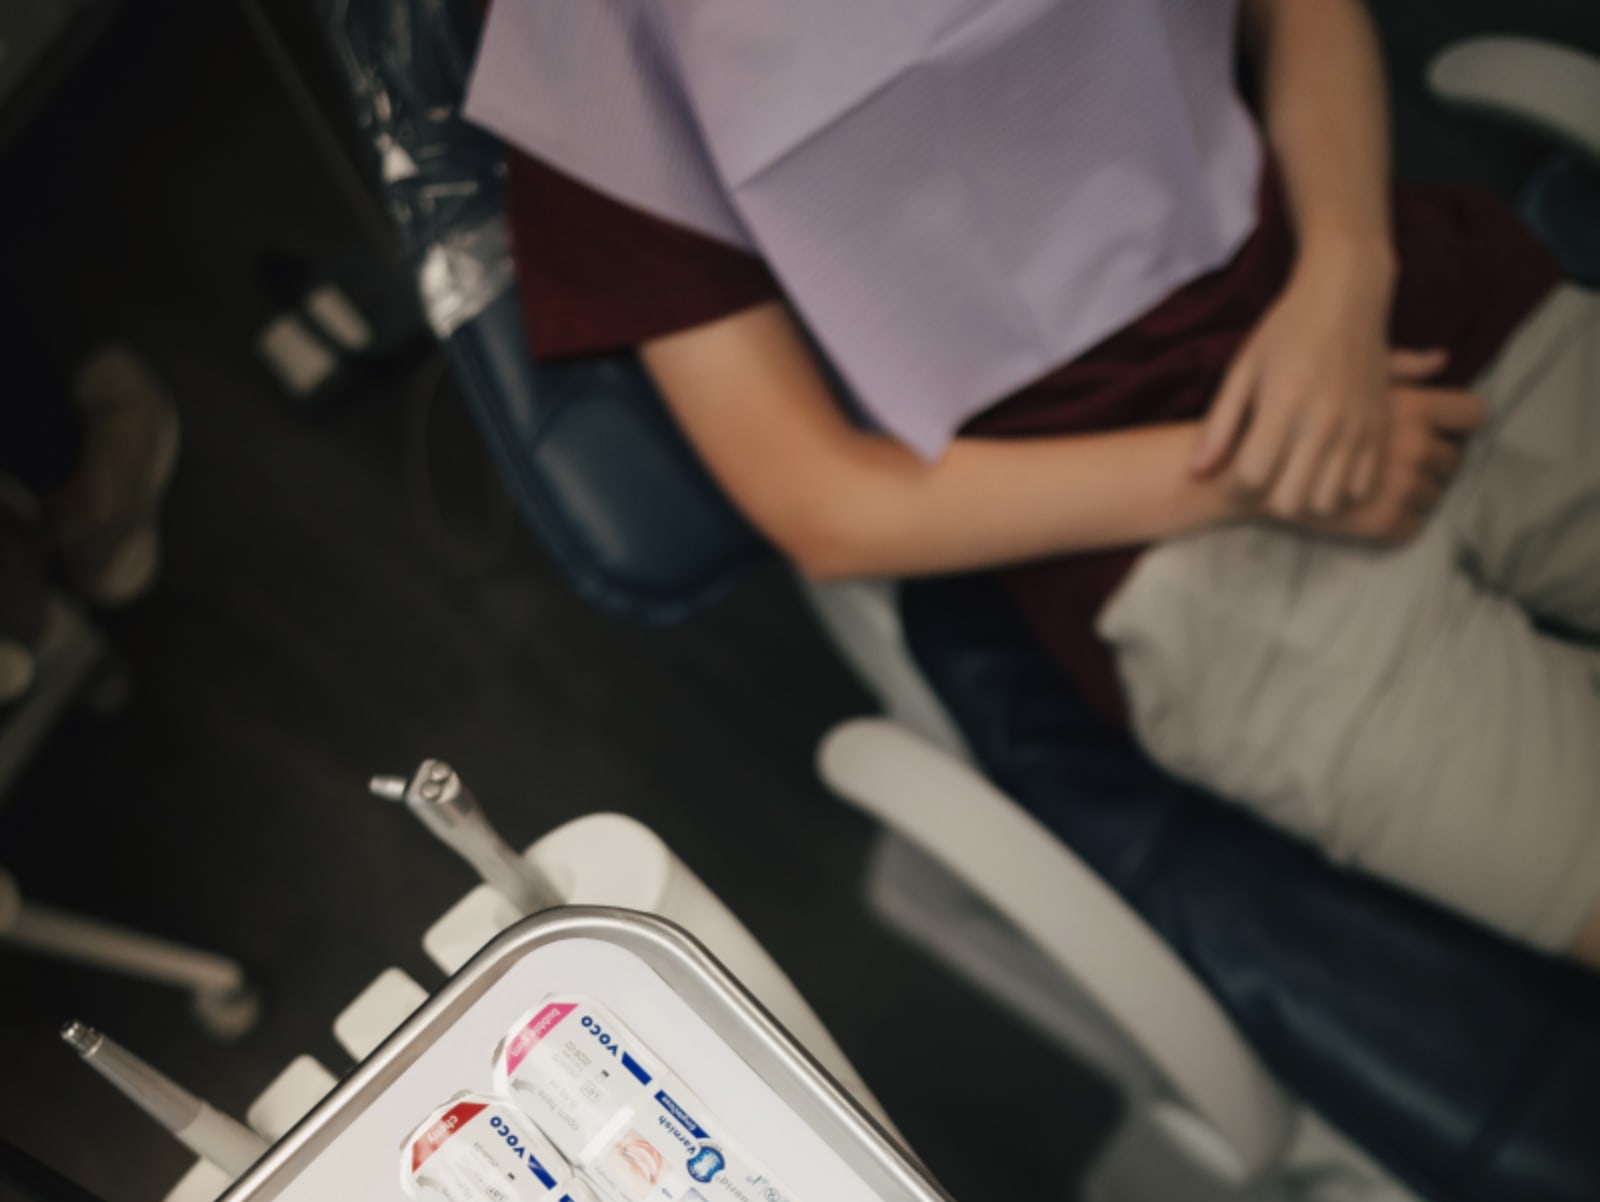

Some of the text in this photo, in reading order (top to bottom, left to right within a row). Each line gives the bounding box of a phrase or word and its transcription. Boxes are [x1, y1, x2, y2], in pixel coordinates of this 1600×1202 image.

[579, 1014, 622, 1057] VOCO
[488, 1114, 529, 1159] VOCO
[656, 1114, 698, 1156] Varnish
